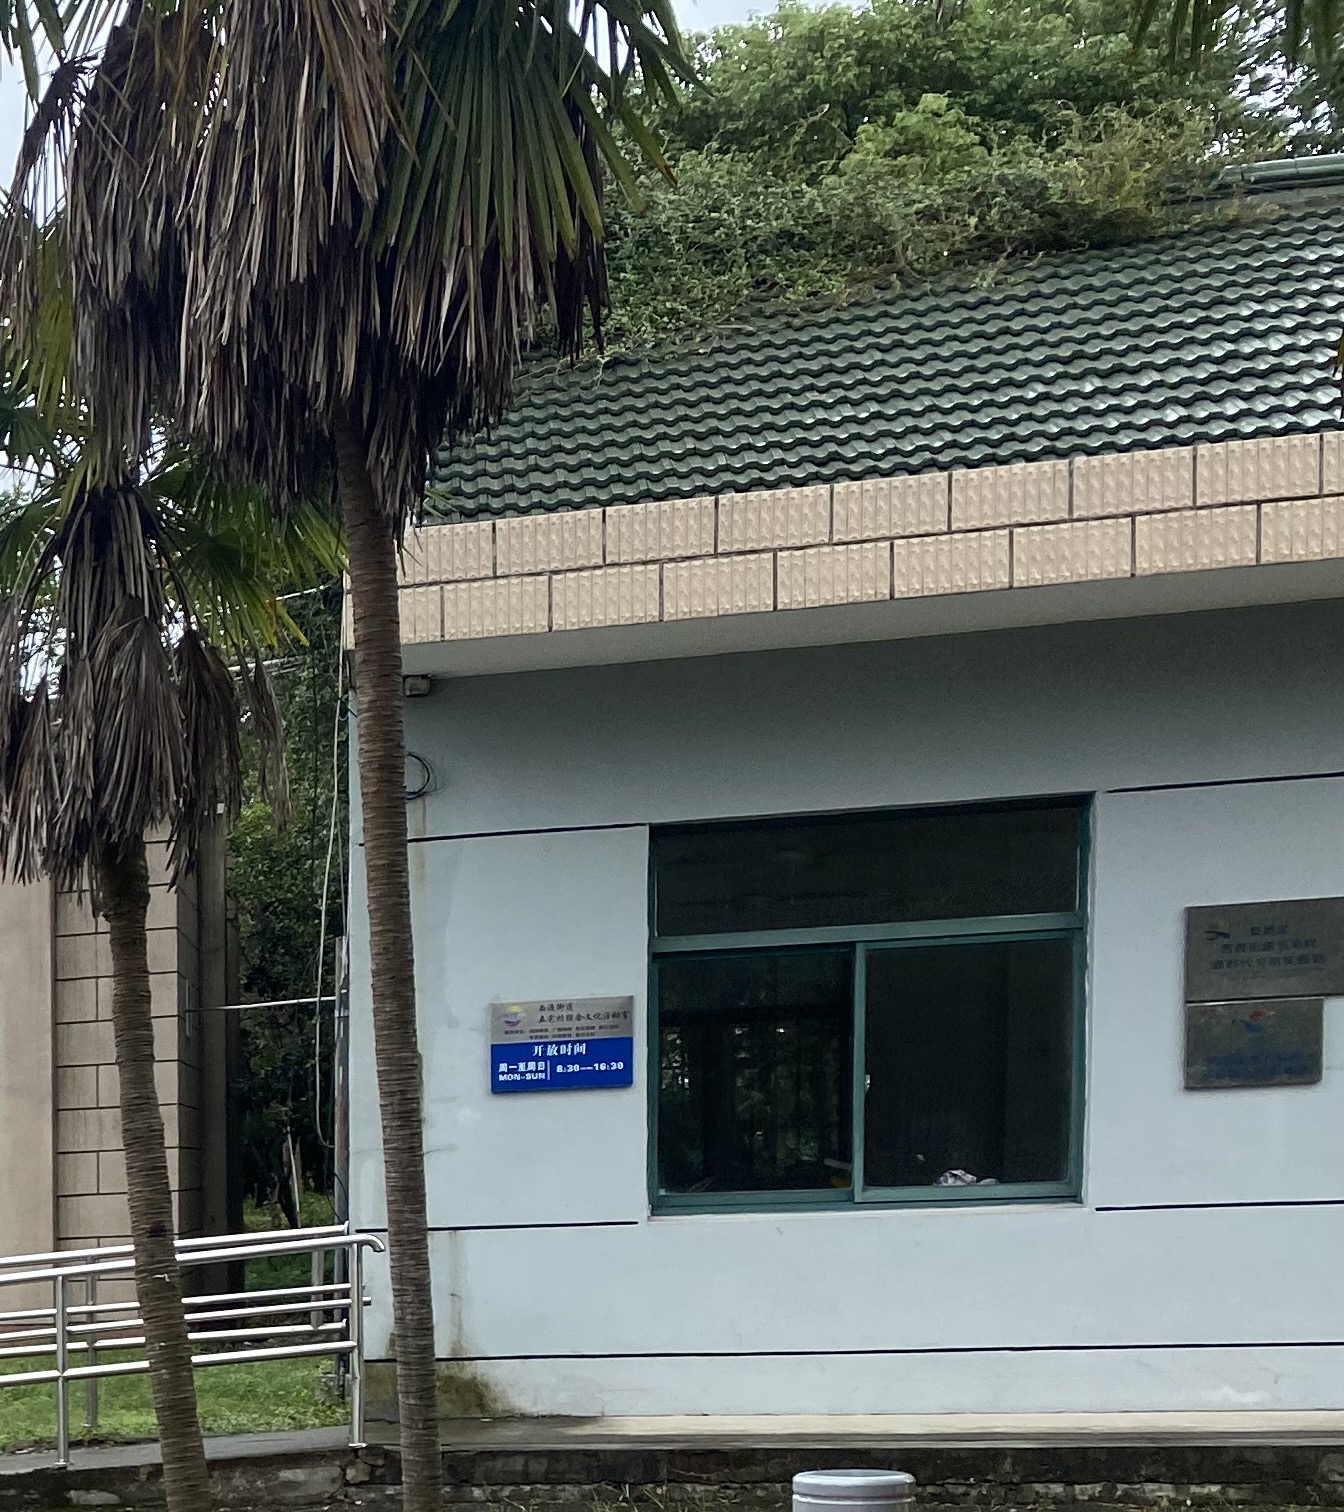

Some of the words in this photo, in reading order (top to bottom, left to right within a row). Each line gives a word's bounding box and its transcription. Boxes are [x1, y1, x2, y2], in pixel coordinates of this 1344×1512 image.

[532, 1042, 587, 1057] 开放时间
[498, 1061, 546, 1073] 周一至周日
[498, 1072, 546, 1082] MON-SUN
